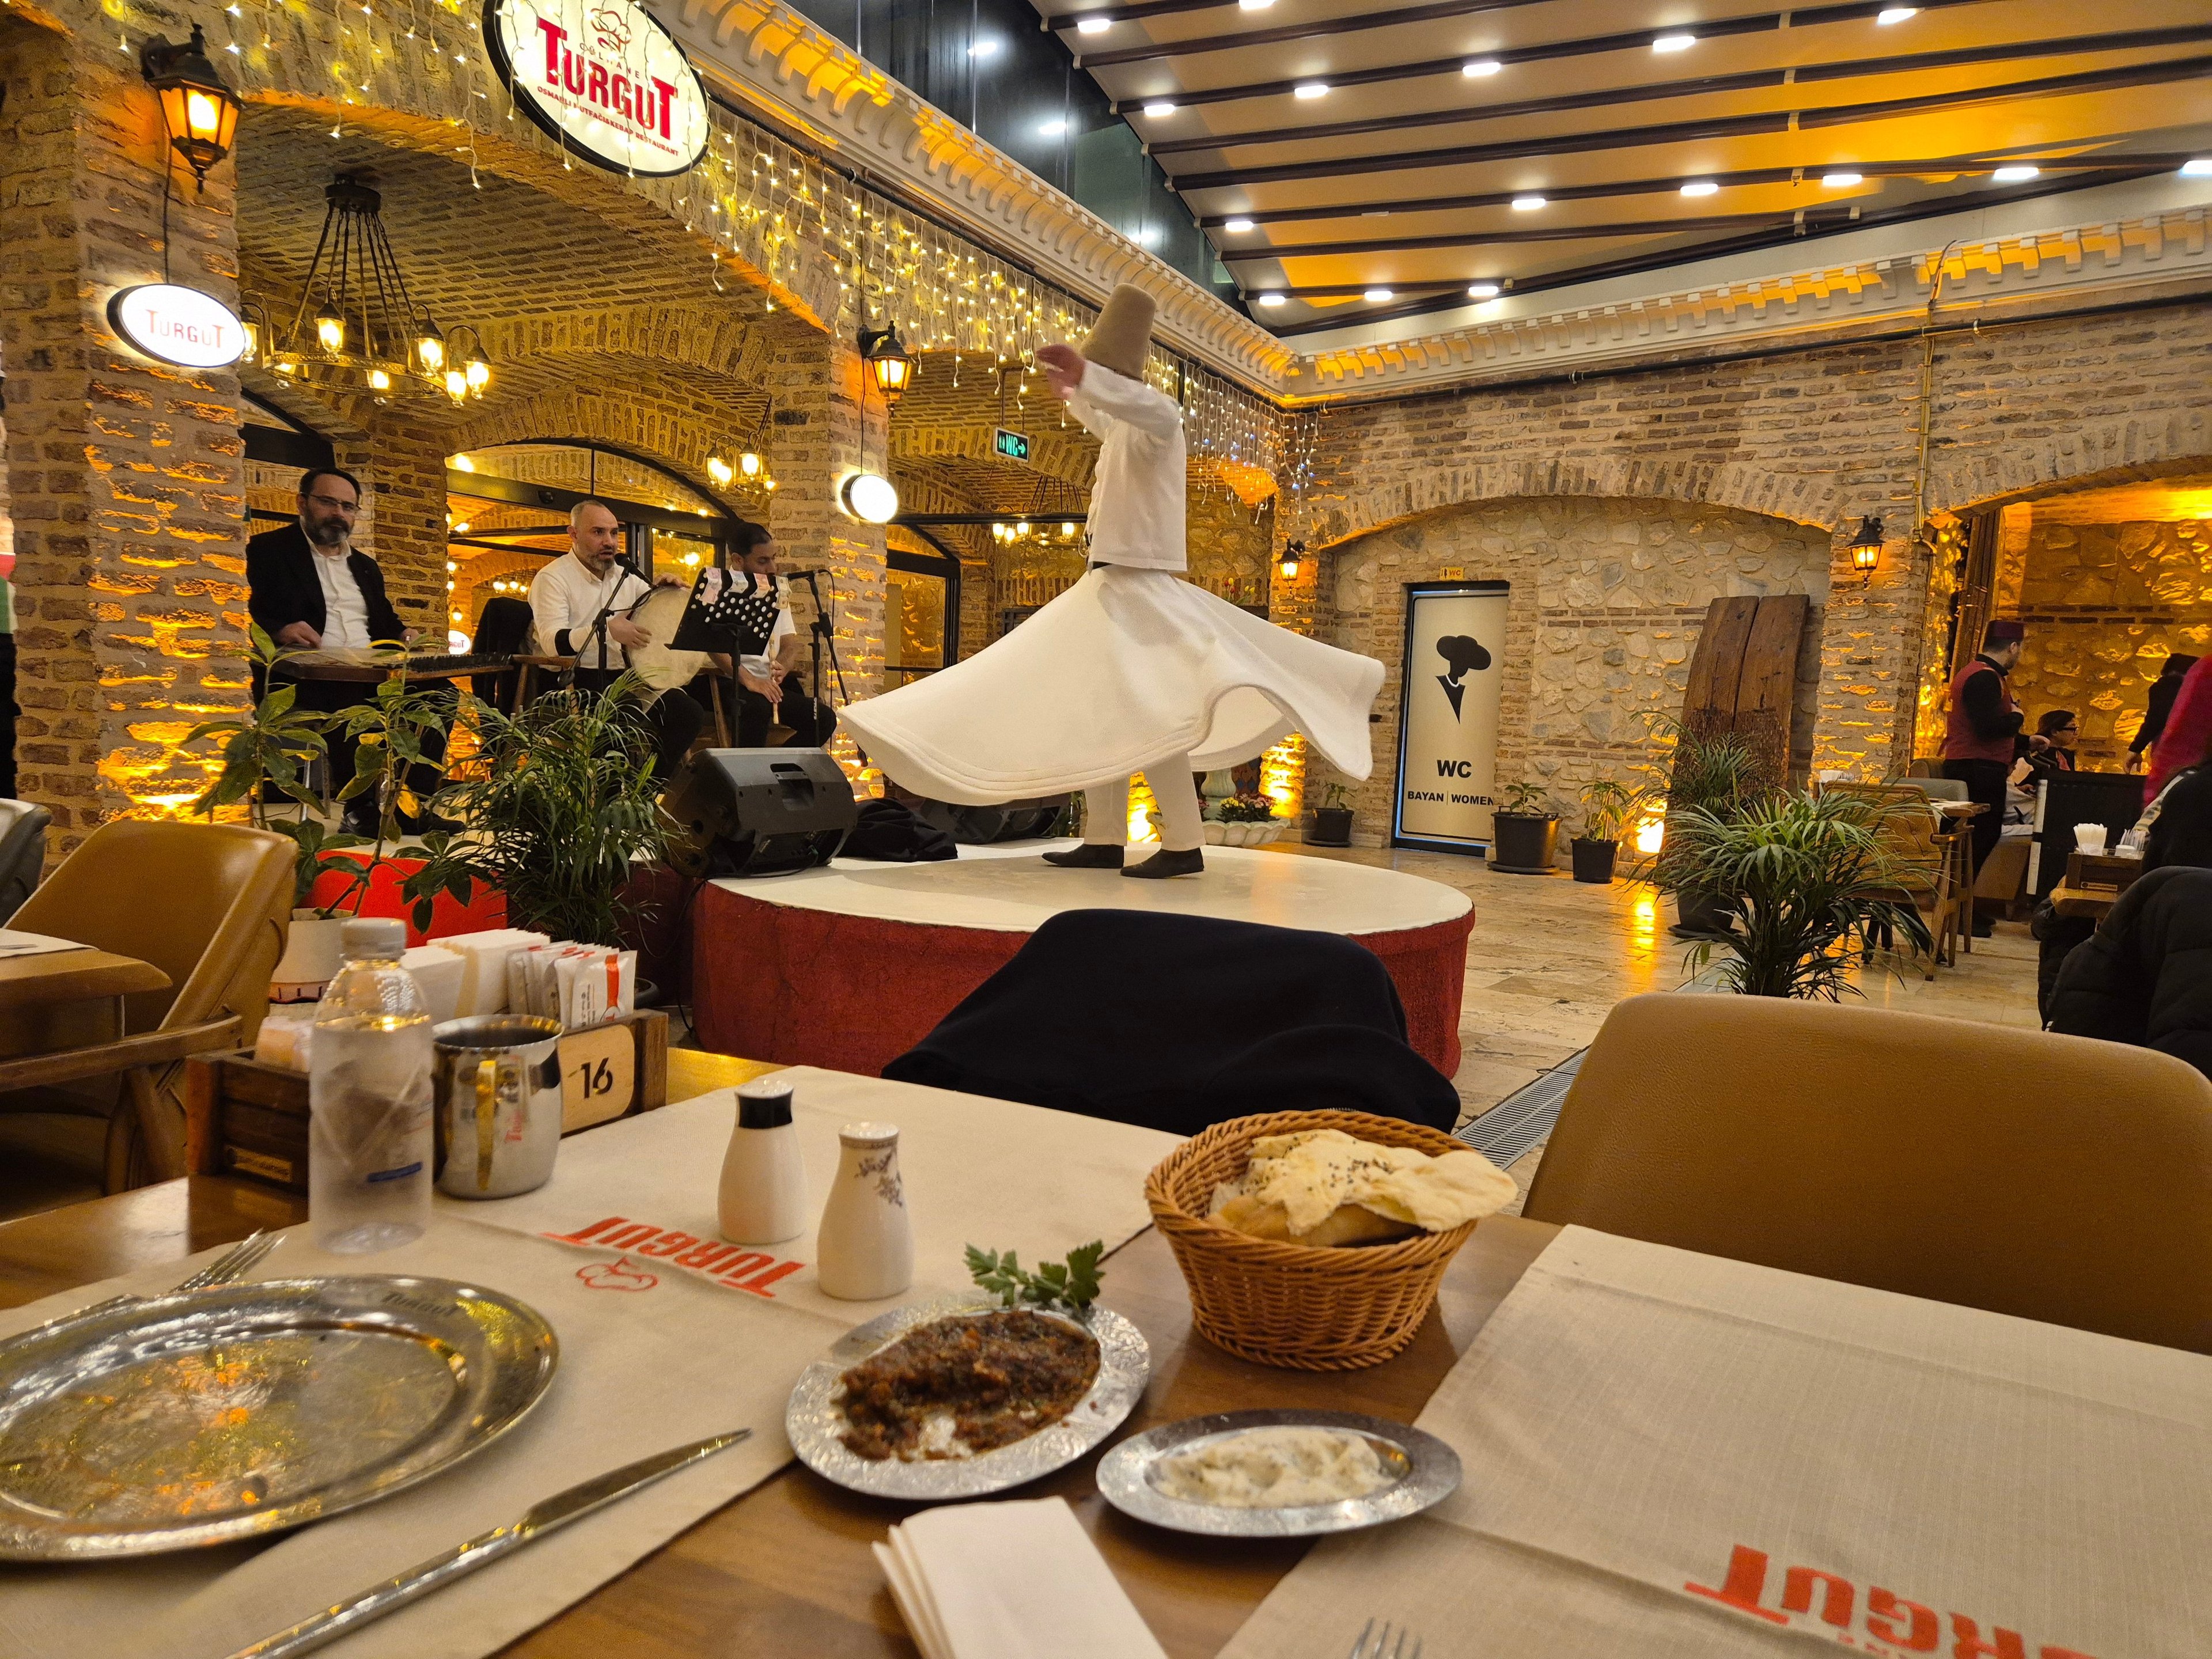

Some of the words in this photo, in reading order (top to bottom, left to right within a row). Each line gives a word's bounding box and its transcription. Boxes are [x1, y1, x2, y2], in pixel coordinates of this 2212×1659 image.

[537, 18, 679, 141] TURGUT
[579, 42, 640, 79] GÜLANE
[635, 131, 679, 157] RESTAURANT
[145, 309, 225, 349] TURGUT
[1006, 434, 1018, 456] WC
[1437, 759, 1472, 778] WC
[1407, 790, 1444, 802] BAYAN
[581, 1057, 613, 1099] 16
[538, 1216, 806, 1298] TURGUT
[1683, 1544, 2099, 1659] RGUT
